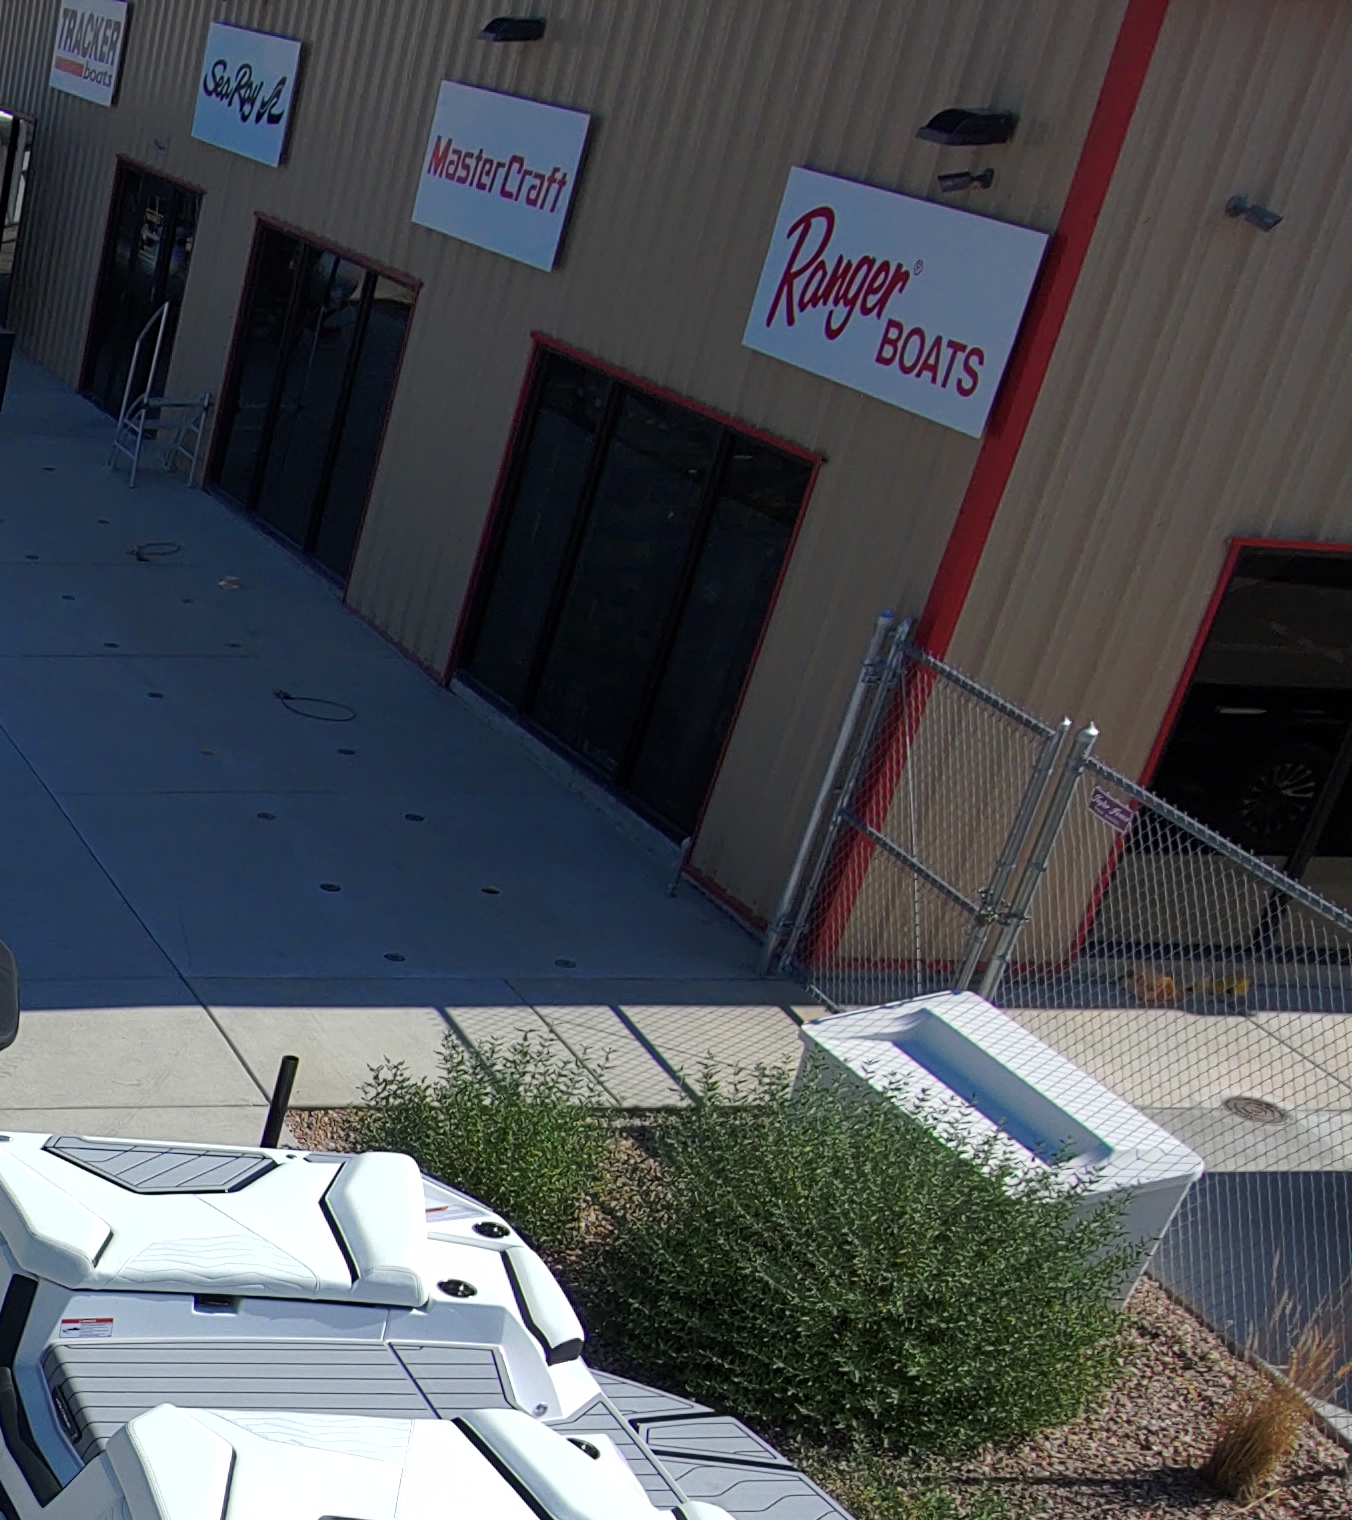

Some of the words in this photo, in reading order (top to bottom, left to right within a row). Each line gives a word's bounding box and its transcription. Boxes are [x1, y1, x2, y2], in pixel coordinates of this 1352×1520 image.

[58, 8, 122, 66] TRACKER
[83, 60, 113, 87] boats
[427, 135, 567, 213] MasterCraft
[766, 206, 911, 340] Ranger
[875, 318, 985, 398] BOATS
